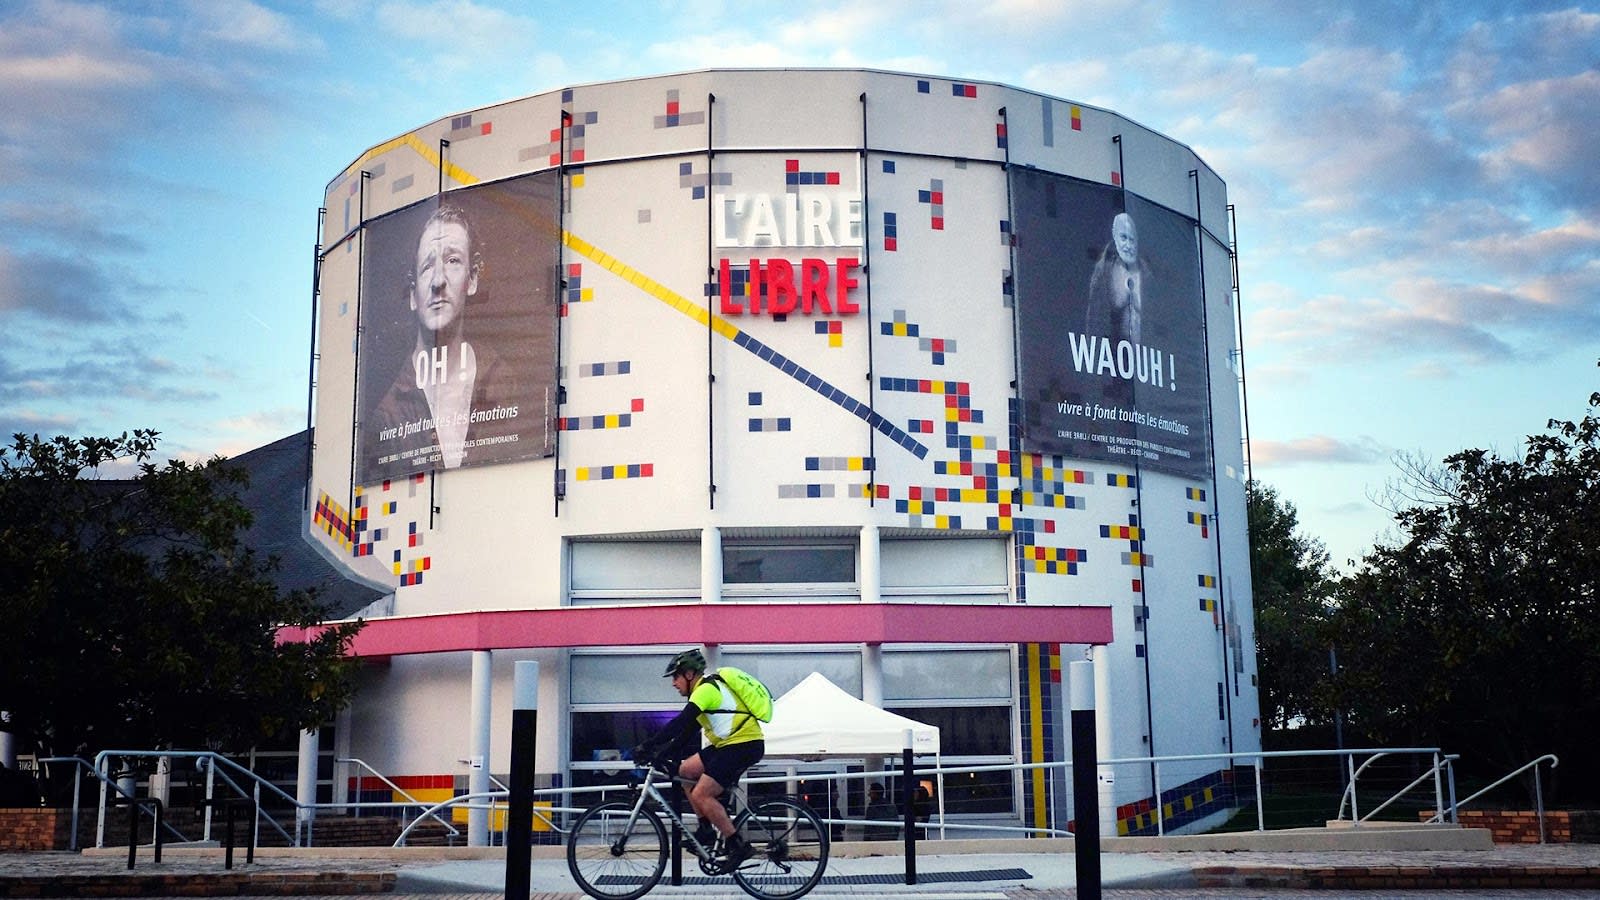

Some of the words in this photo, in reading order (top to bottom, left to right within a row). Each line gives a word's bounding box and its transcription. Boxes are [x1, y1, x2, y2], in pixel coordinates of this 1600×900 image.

[715, 193, 863, 248] L'AIRE
[720, 258, 860, 314] LIBRE
[416, 346, 448, 390] OH
[459, 342, 468, 382] !
[1068, 332, 1163, 388] WAOUH
[1169, 354, 1177, 392] !
[379, 426, 398, 442] vivre
[398, 423, 403, 437] à
[403, 417, 422, 438] fond
[422, 414, 450, 431] toutes
[453, 412, 468, 425] les
[470, 404, 518, 424] émotions
[1057, 400, 1083, 416] vivre
[1084, 402, 1092, 417] à
[1092, 404, 1117, 421] fond
[1118, 408, 1146, 425] toutes
[1146, 412, 1158, 428] les
[1158, 416, 1190, 436] émotions
